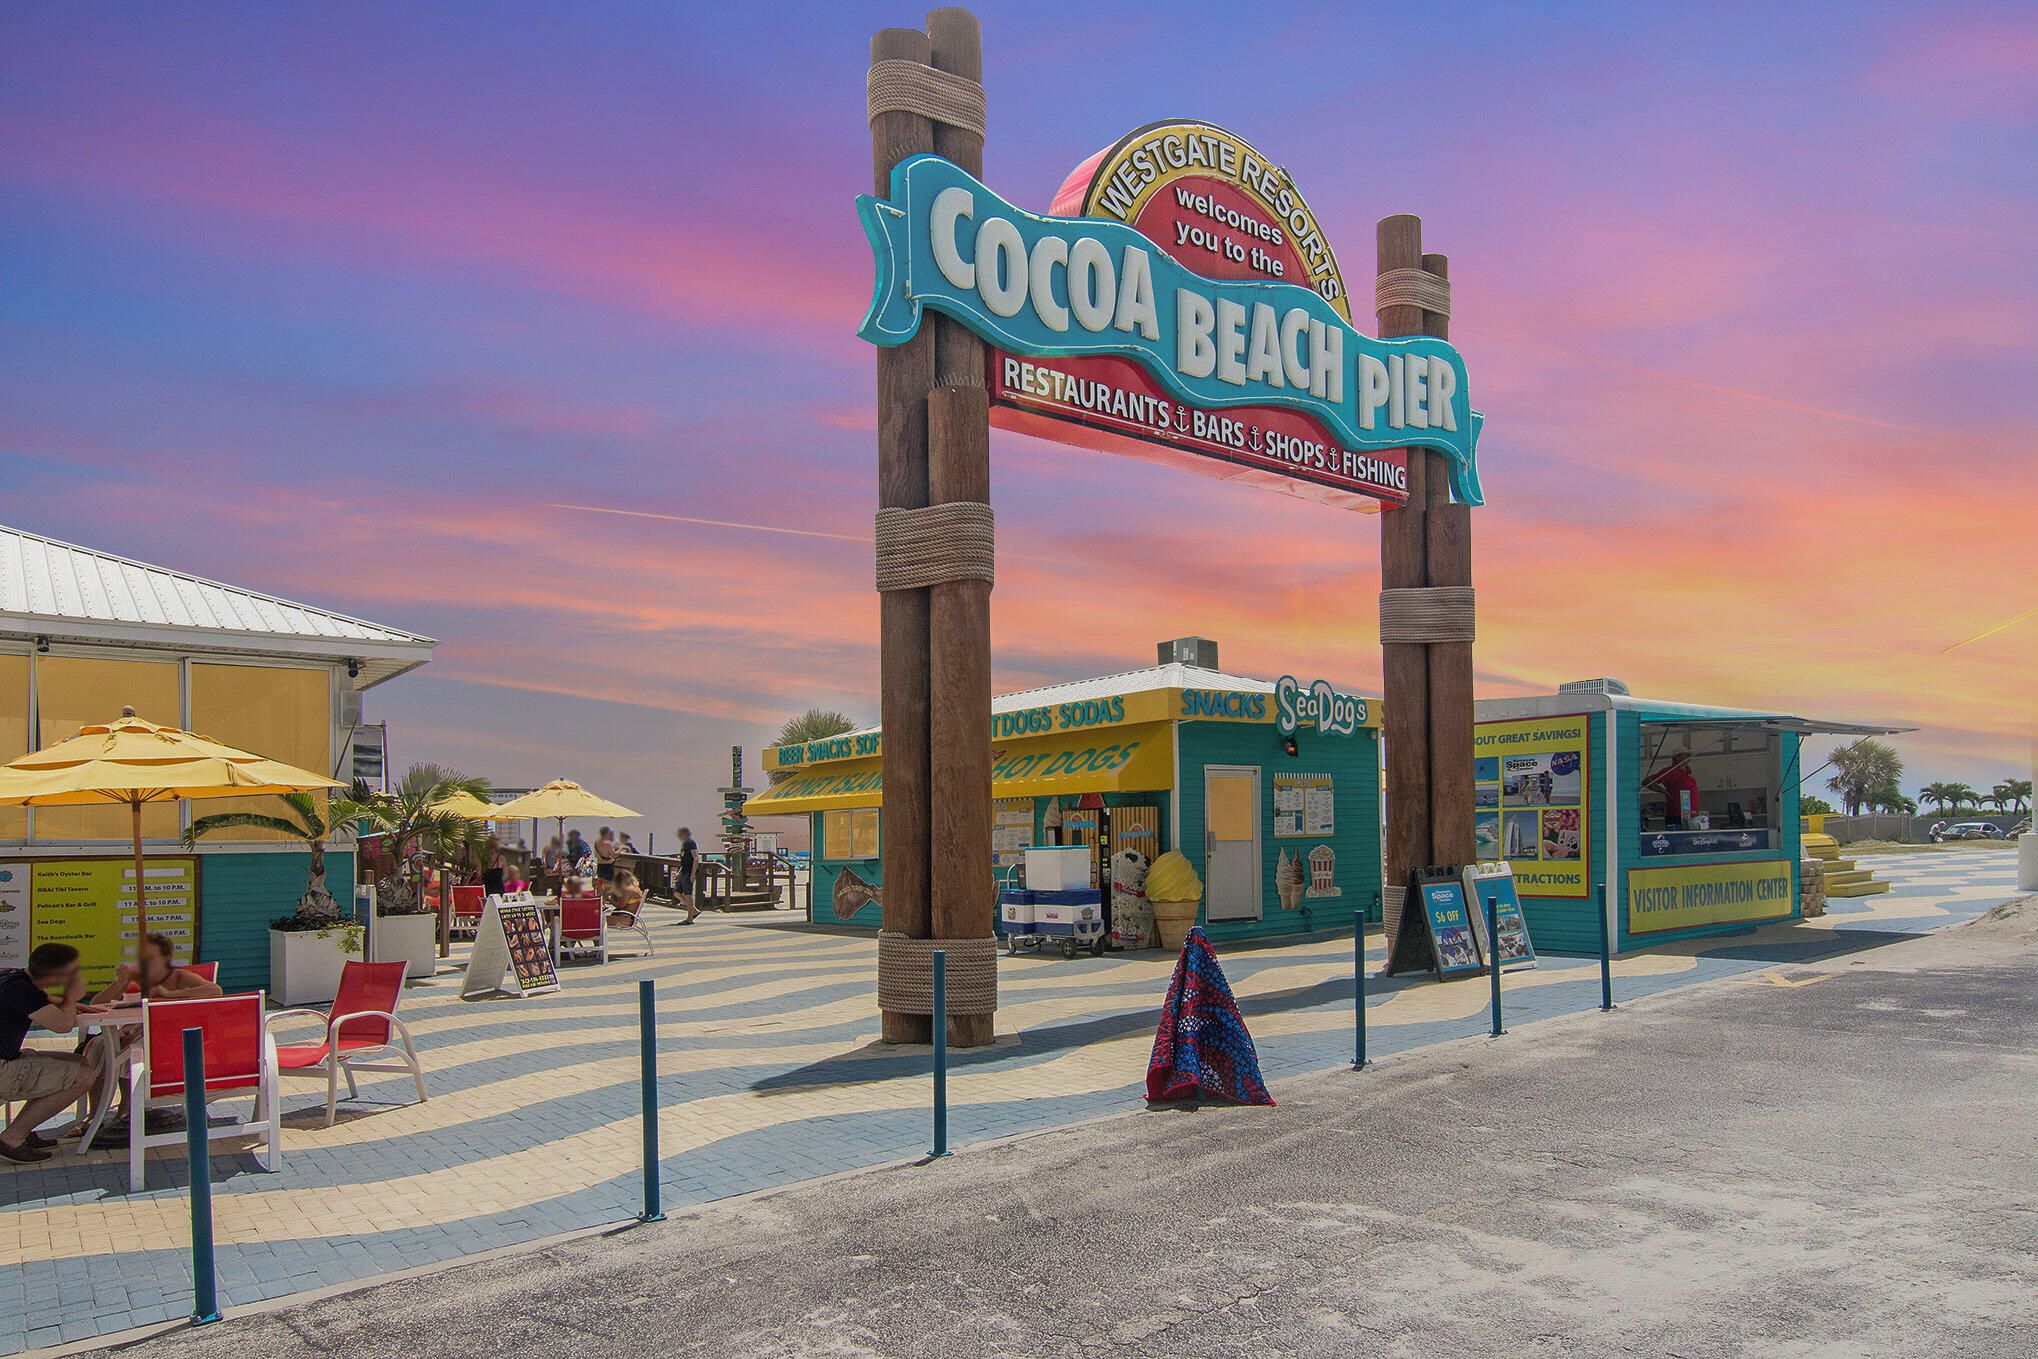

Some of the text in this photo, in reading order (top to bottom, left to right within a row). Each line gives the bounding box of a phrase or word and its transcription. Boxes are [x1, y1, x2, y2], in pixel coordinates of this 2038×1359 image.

[1100, 134, 1340, 301] WESTGATE RESORTS
[1175, 186, 1283, 246] welcomes
[1176, 220, 1284, 277] you to the
[930, 187, 1457, 431] COCOA BEACH PIER
[1004, 357, 1406, 489] RESTAURANTS BARS SHOPS FISHING
[1002, 706, 1052, 737] DOGS
[1059, 695, 1125, 729] SODAS
[1182, 688, 1266, 719] SNACKS
[778, 745, 804, 766] BEER
[806, 737, 852, 762] SNACKS
[1498, 732, 1531, 744] GREAT
[1532, 728, 1581, 742] SAVINGS!
[992, 741, 1141, 780] HOT DOGS
[1505, 760, 1538, 770] Space
[1512, 872, 1582, 885] TRACTIONS
[1633, 877, 1789, 913] VISITOR INFORMATION CENTER
[1435, 910, 1459, 923] $6 OFF
